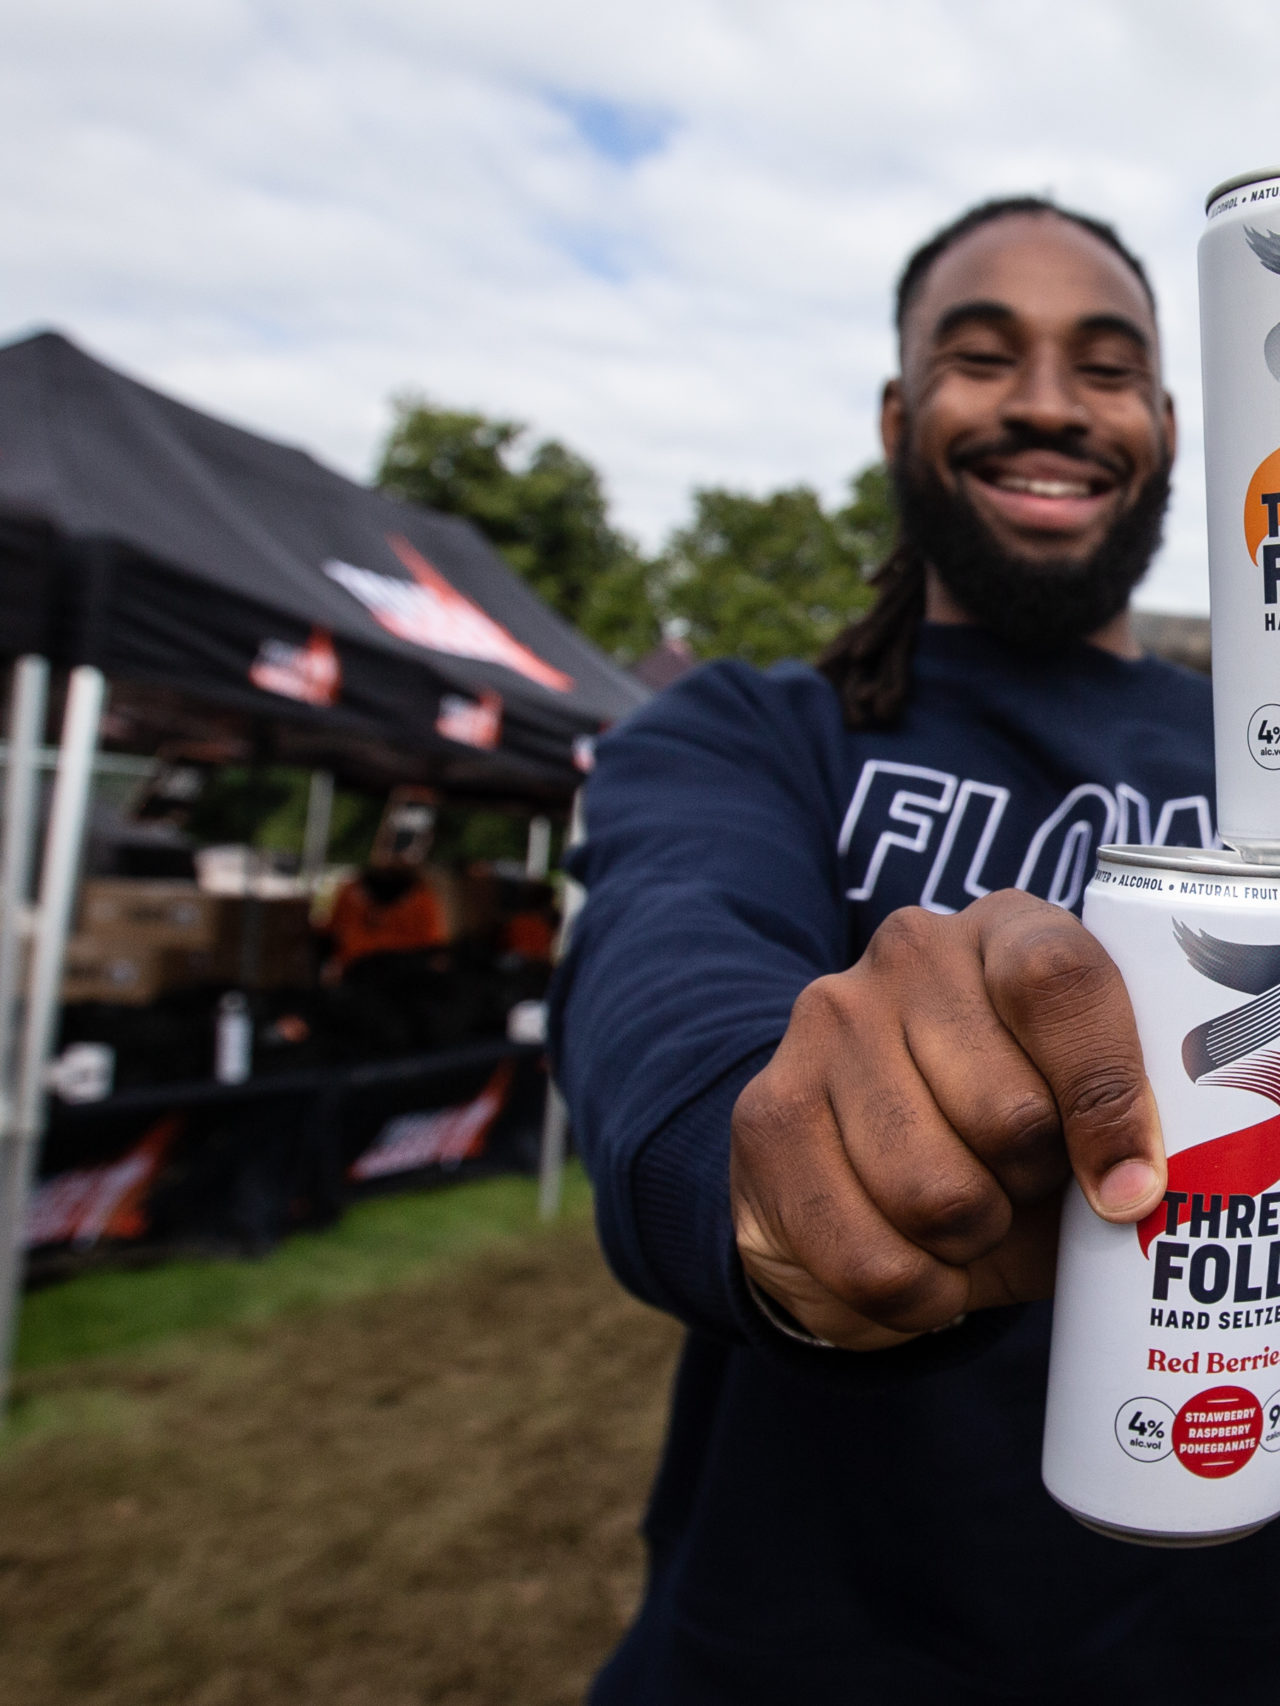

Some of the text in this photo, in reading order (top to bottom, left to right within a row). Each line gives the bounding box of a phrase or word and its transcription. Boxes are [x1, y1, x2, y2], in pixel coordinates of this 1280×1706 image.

[1118, 873, 1164, 891] ALCOHOL
[1179, 881, 1239, 898] NATURAL
[1244, 886, 1279, 901] FRUIT
[1150, 1307, 1210, 1330] HARD
[1147, 1348, 1200, 1374] Red
[1128, 1411, 1165, 1439] 4%
[1184, 1407, 1257, 1424] STRAWBERRY
[1188, 1423, 1252, 1439] RASPBERRY
[1129, 1438, 1162, 1450] alc.vol
[1179, 1437, 1256, 1455] POMEGRANATE
